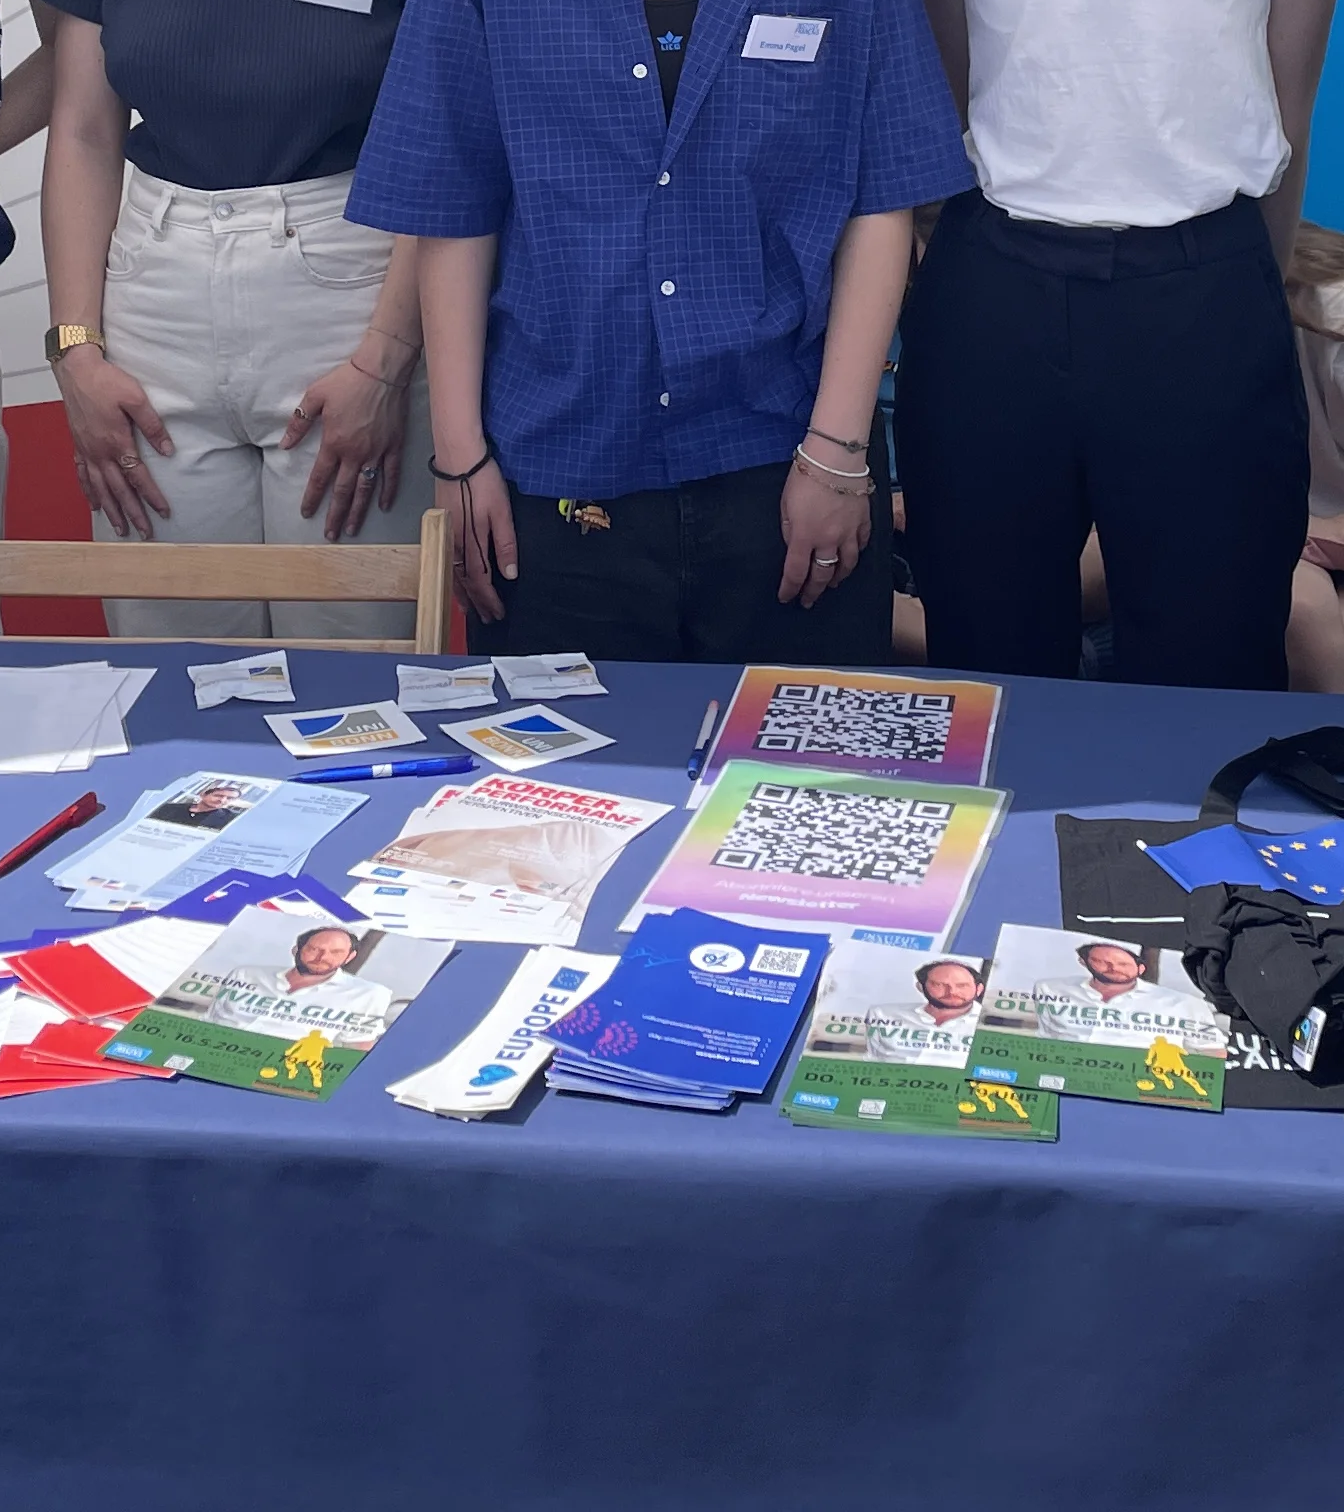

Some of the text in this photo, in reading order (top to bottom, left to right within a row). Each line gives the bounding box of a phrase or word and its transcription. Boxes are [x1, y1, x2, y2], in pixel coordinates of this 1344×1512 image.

[759, 41, 784, 51] Emma
[347, 719, 387, 735] UNI
[330, 731, 395, 746] BONN
[481, 736, 530, 758] BONN
[521, 736, 556, 753] UNI
[483, 777, 622, 812] KÖRPER
[471, 786, 644, 826] PERFORMANZ
[738, 893, 861, 910] Newsletter
[190, 971, 258, 991] LESUNG
[178, 980, 386, 1027] OLIVIER GUEZ
[997, 989, 1071, 1003] LESUNG
[830, 1015, 903, 1027] LESUNG
[994, 999, 1220, 1033] OLIVIER GUEZ
[494, 993, 570, 1061] EUROPE
[824, 1023, 953, 1044] OLIVIER
[1025, 1052, 1125, 1071] 16.5.2024
[850, 1075, 949, 1092] 16.5.2024
